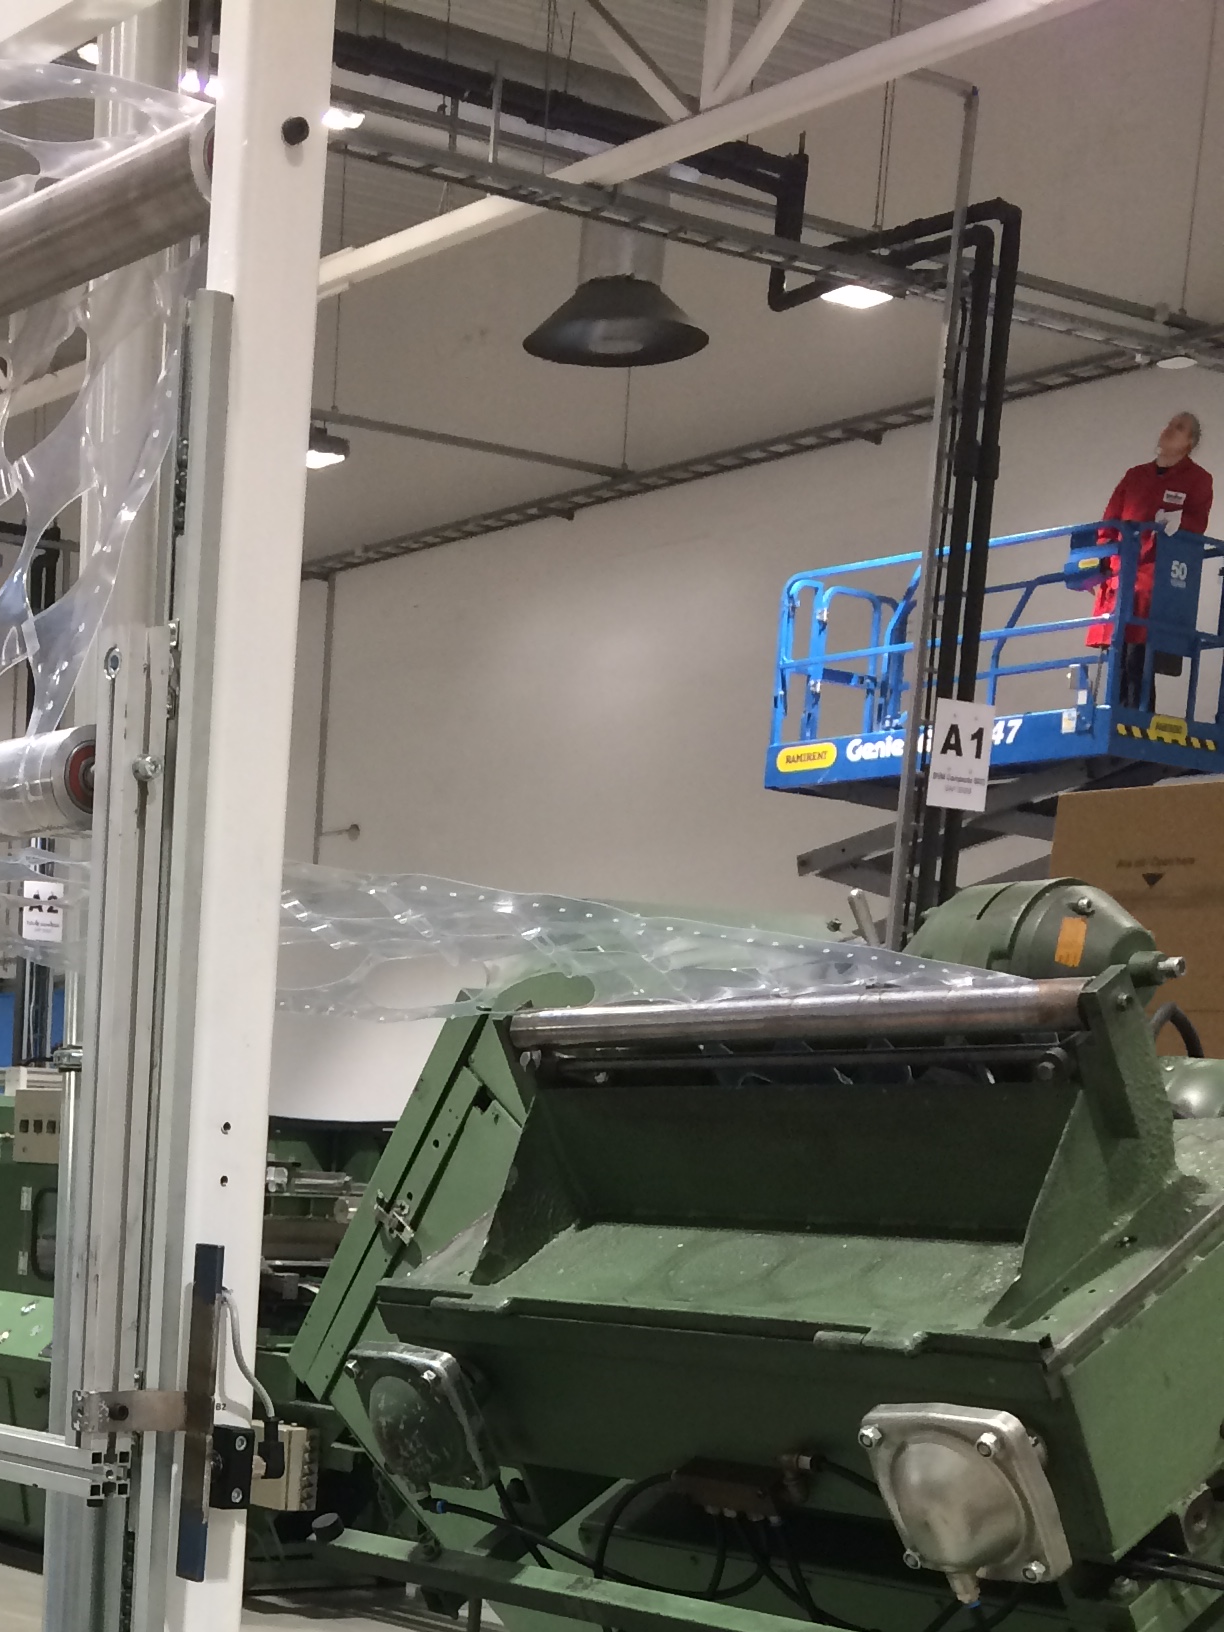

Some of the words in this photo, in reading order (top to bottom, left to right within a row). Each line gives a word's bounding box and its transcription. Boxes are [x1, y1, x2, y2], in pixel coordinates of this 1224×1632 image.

[846, 735, 905, 762] Genie
[939, 723, 985, 760] A1
[785, 750, 828, 763] RAMIRENT
[28, 893, 59, 914] A2
[215, 1402, 227, 1411] B2
